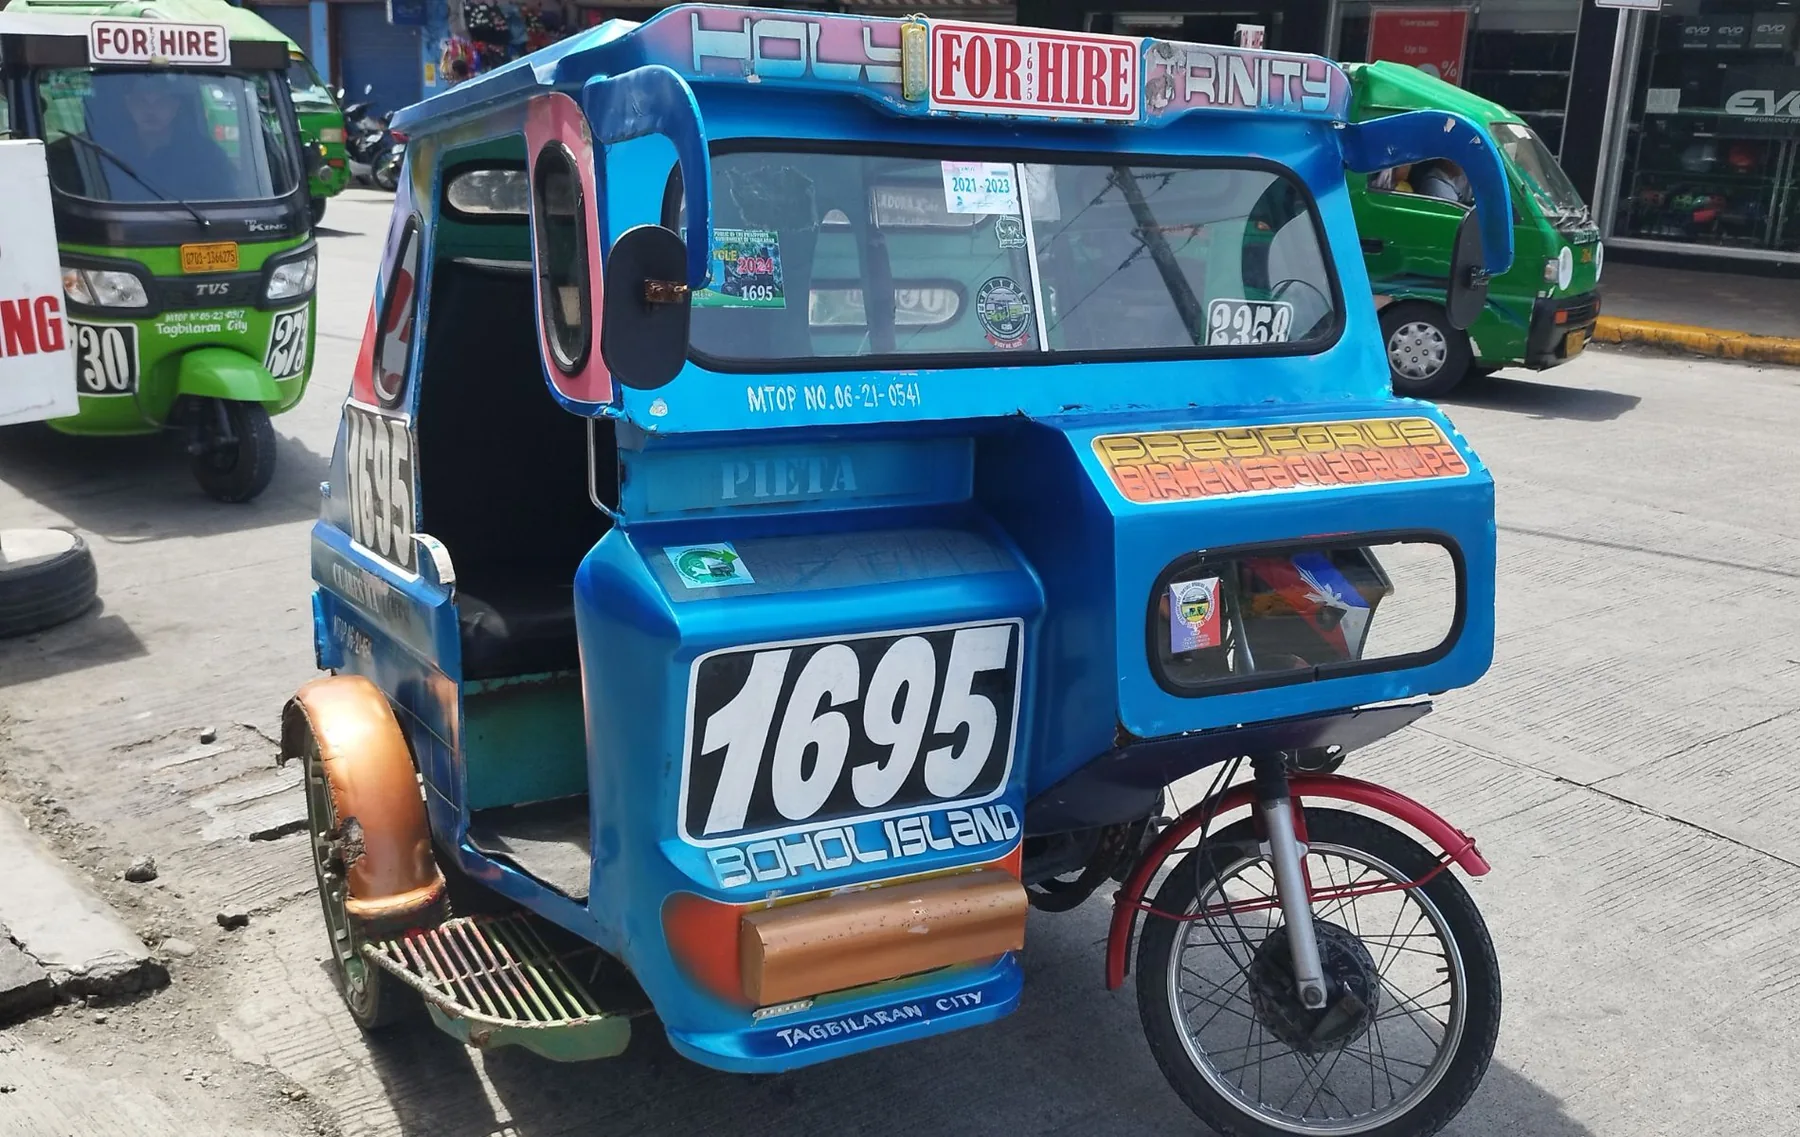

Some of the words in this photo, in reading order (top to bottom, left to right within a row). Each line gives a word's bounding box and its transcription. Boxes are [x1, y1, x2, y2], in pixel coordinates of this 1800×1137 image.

[97, 28, 148, 55] FOR
[160, 30, 218, 57] HIRE
[1685, 26, 1711, 35] EVO
[1718, 26, 1744, 35] EVO
[1756, 23, 1787, 33] EVO
[691, 12, 902, 83] HOLY
[939, 33, 1022, 100] FOR
[1037, 41, 1129, 107] HIRE
[1155, 51, 1332, 111] TRINITY
[952, 177, 977, 192] 2021
[985, 178, 1010, 193] 2023
[713, 250, 737, 260] YCLE
[737, 257, 774, 275] 2024
[196, 283, 230, 295] TVS
[741, 285, 773, 301] 1695
[0, 296, 65, 357] NG
[155, 321, 221, 338] Tagbilaran
[226, 320, 248, 333] City
[1210, 303, 1288, 345] 2358
[747, 386, 797, 413] MTOP
[1261, 422, 1370, 455] FOR
[1362, 418, 1442, 448] US
[349, 410, 410, 566] 1695
[721, 455, 858, 500] PIETA
[701, 624, 1013, 836] 1695
[707, 826, 888, 889] BOHOL
[884, 804, 1020, 858] ISLAND
[776, 1003, 923, 1048] TAGBILARAN
[935, 991, 983, 1012] CITY
